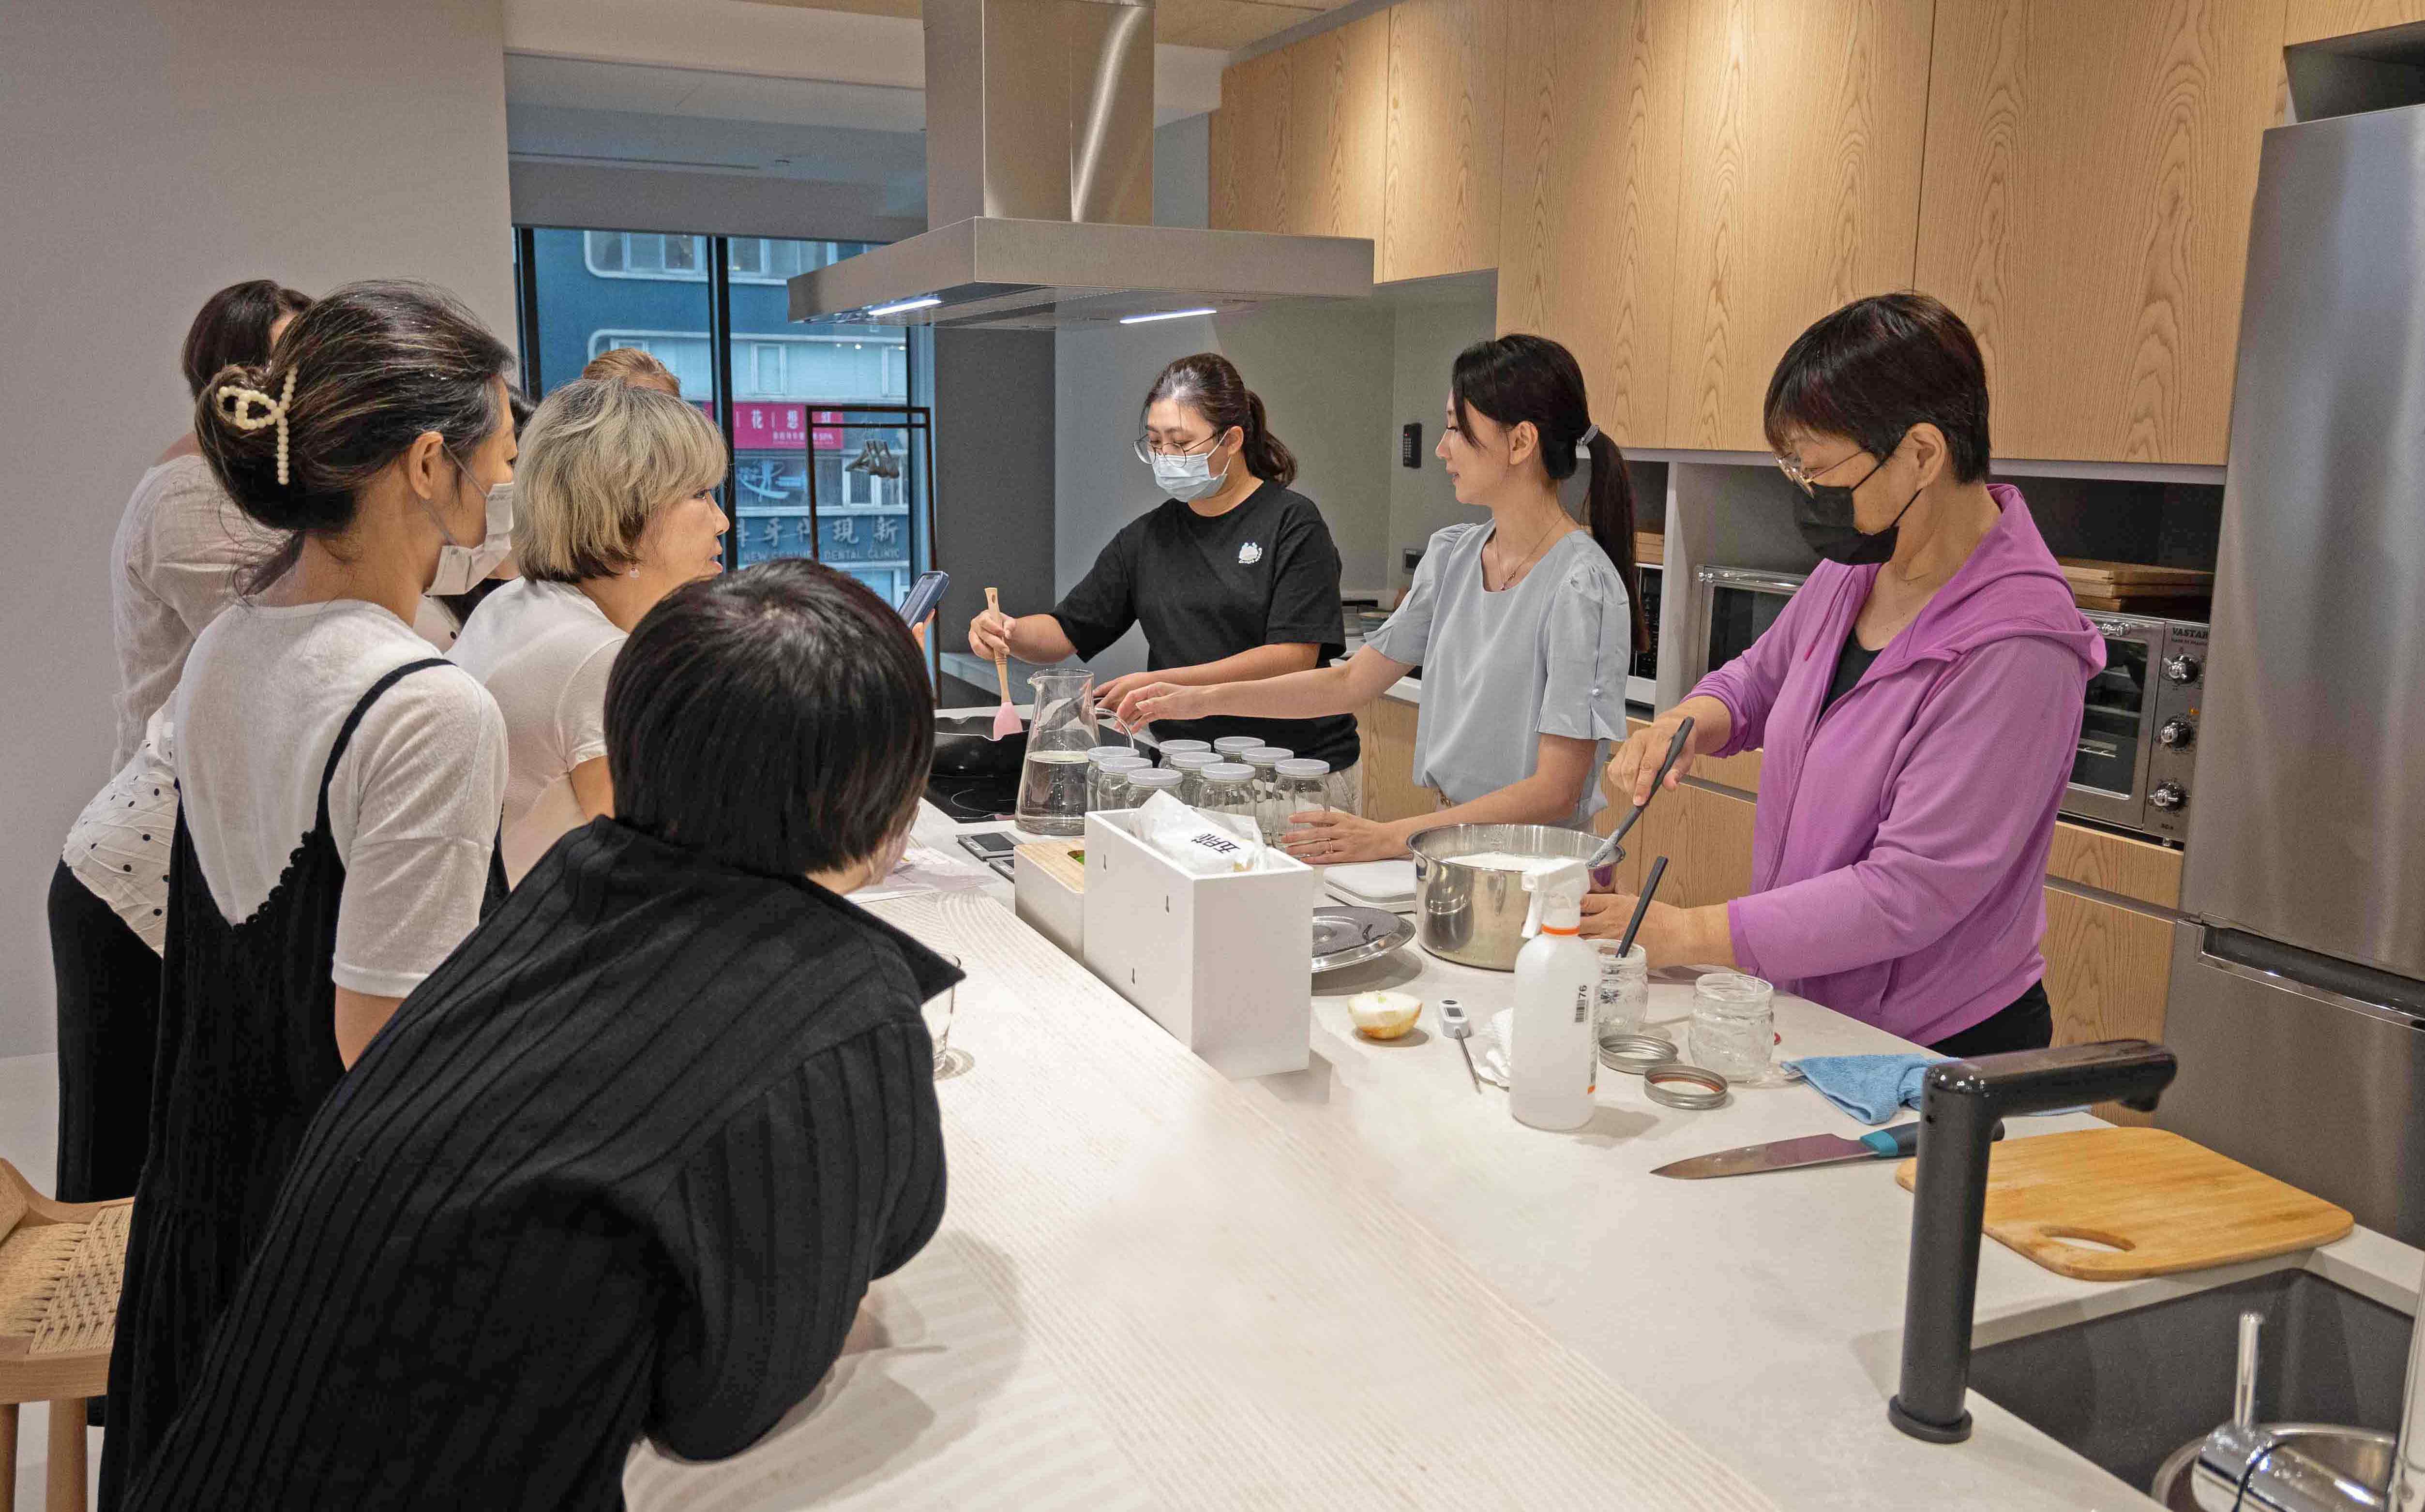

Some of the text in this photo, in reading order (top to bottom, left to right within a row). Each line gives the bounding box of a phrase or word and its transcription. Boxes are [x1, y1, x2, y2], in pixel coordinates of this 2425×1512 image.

[824, 549, 861, 561] DENTAL
[867, 547, 900, 559] CLINIC
[1579, 985, 1587, 999] 76
